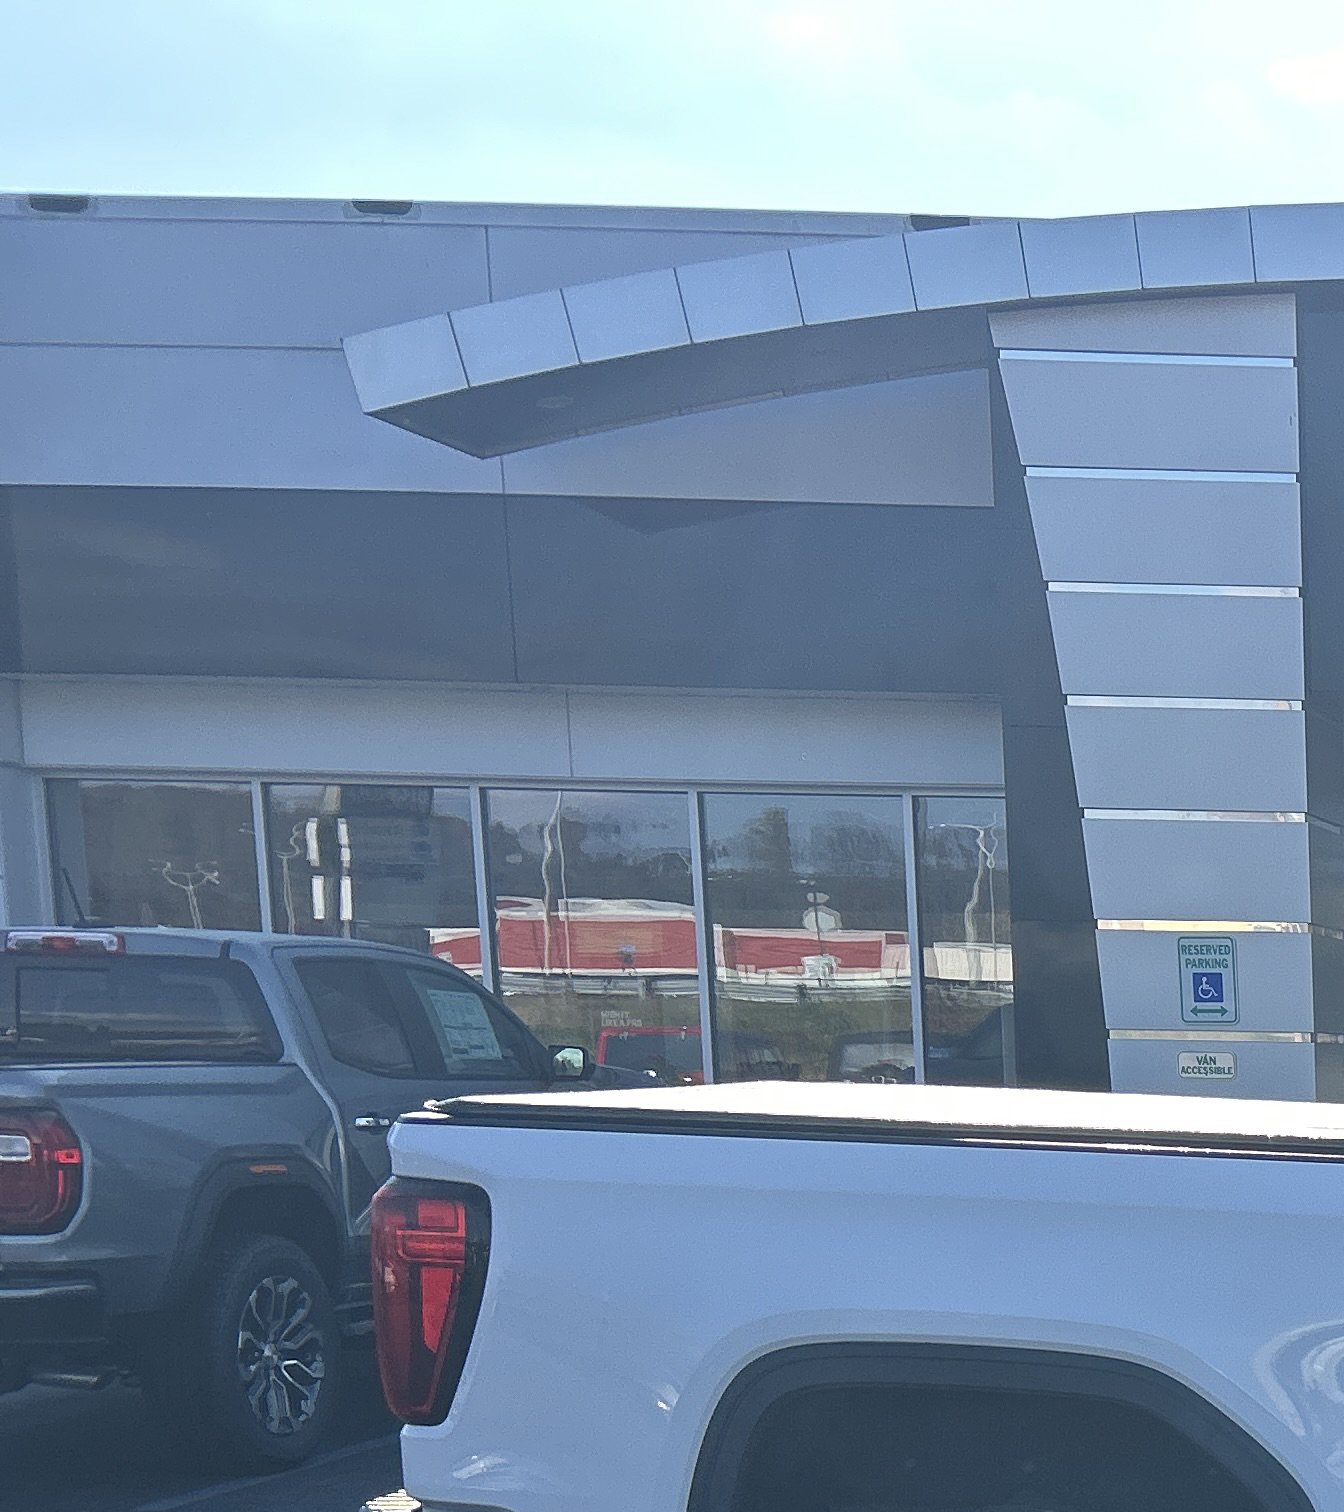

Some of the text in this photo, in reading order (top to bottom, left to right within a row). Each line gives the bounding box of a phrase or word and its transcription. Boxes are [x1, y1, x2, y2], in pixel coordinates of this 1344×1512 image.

[1180, 944, 1231, 956] RESERVED
[1184, 958, 1229, 969] PARKING
[1195, 1055, 1217, 1066] VAN
[1180, 1065, 1234, 1076] ACCESSIBLE
